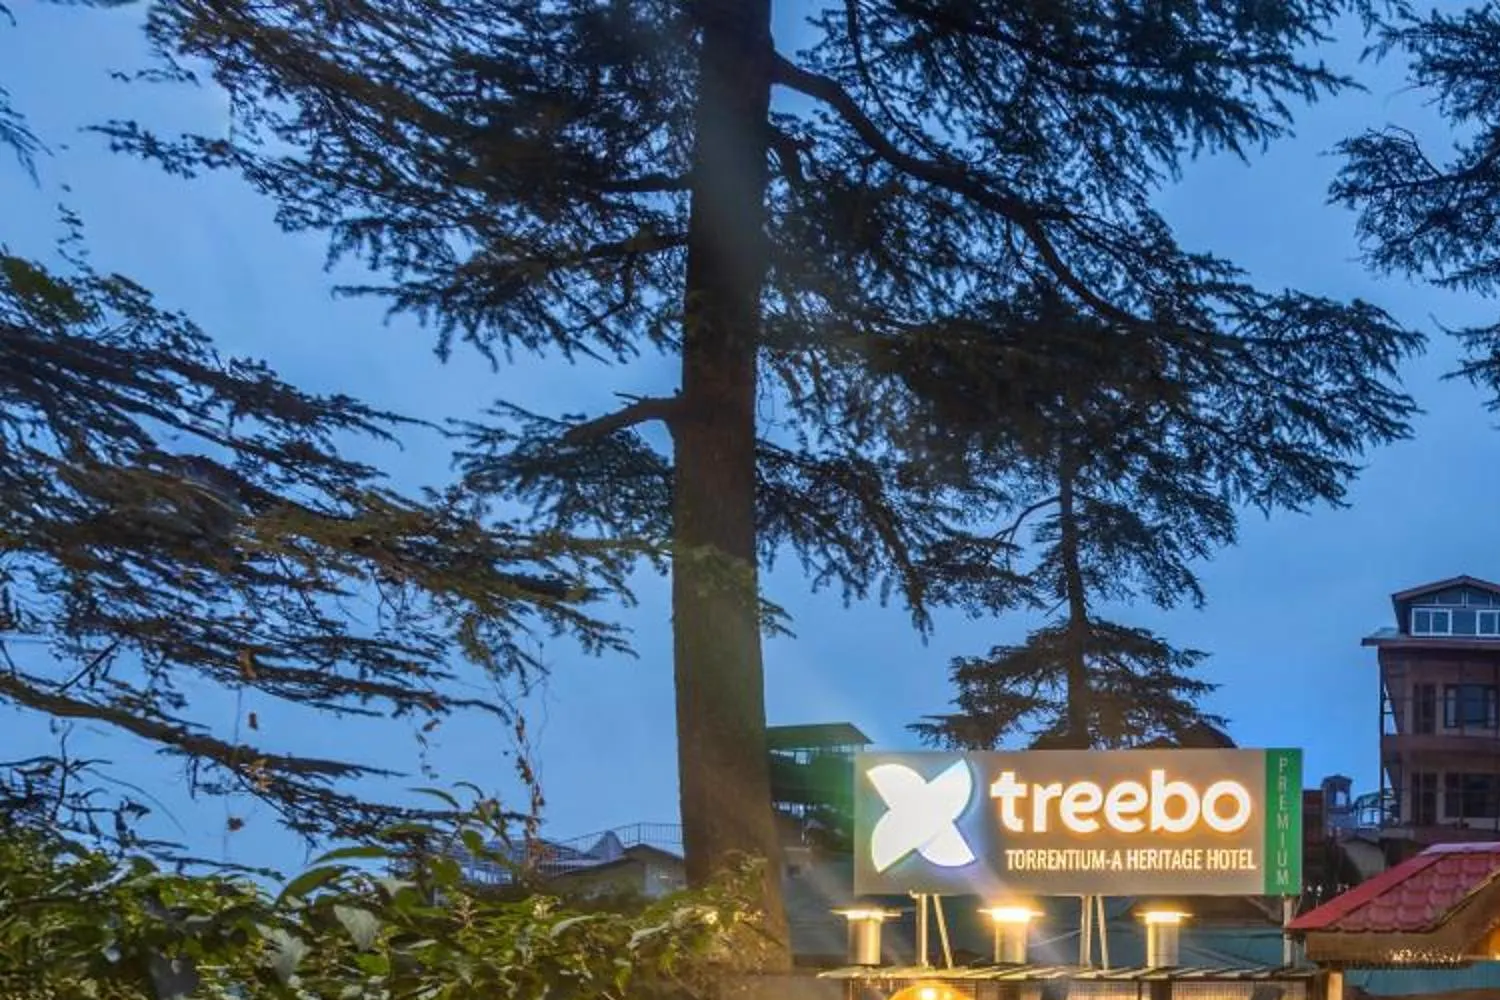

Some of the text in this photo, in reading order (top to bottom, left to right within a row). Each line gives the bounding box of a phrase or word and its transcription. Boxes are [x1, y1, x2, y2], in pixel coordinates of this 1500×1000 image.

[989, 769, 1252, 834] treebo
[1275, 756, 1290, 886] PREMIUM
[1126, 848, 1204, 871] HERITAGE
[1206, 848, 1257, 871] HOTEL
